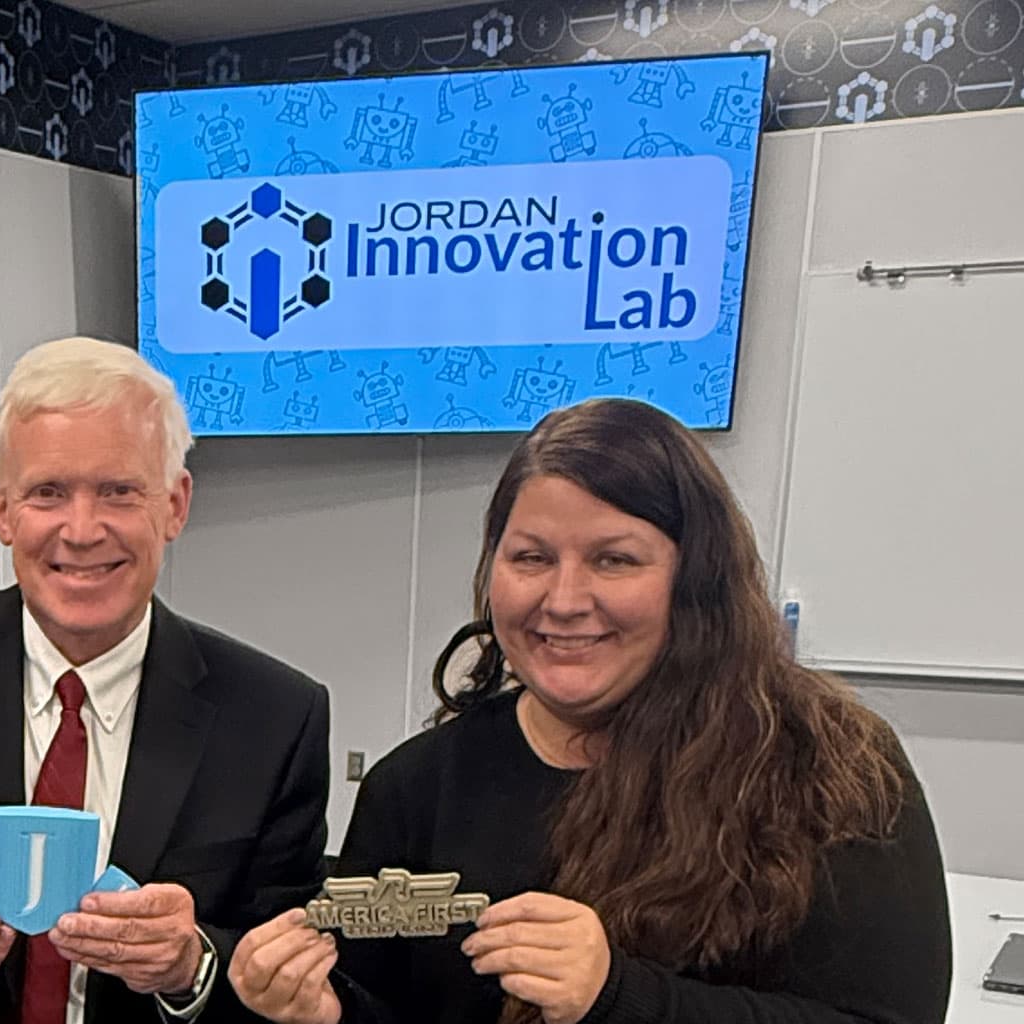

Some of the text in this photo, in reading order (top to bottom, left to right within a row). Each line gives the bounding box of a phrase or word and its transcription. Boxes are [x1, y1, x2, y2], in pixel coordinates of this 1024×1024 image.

[346, 211, 688, 278] Innovation
[366, 195, 558, 233] JORDAN
[583, 246, 697, 331] Lab
[16, 831, 55, 917] J
[305, 901, 483, 926] AMERICA FIRST
